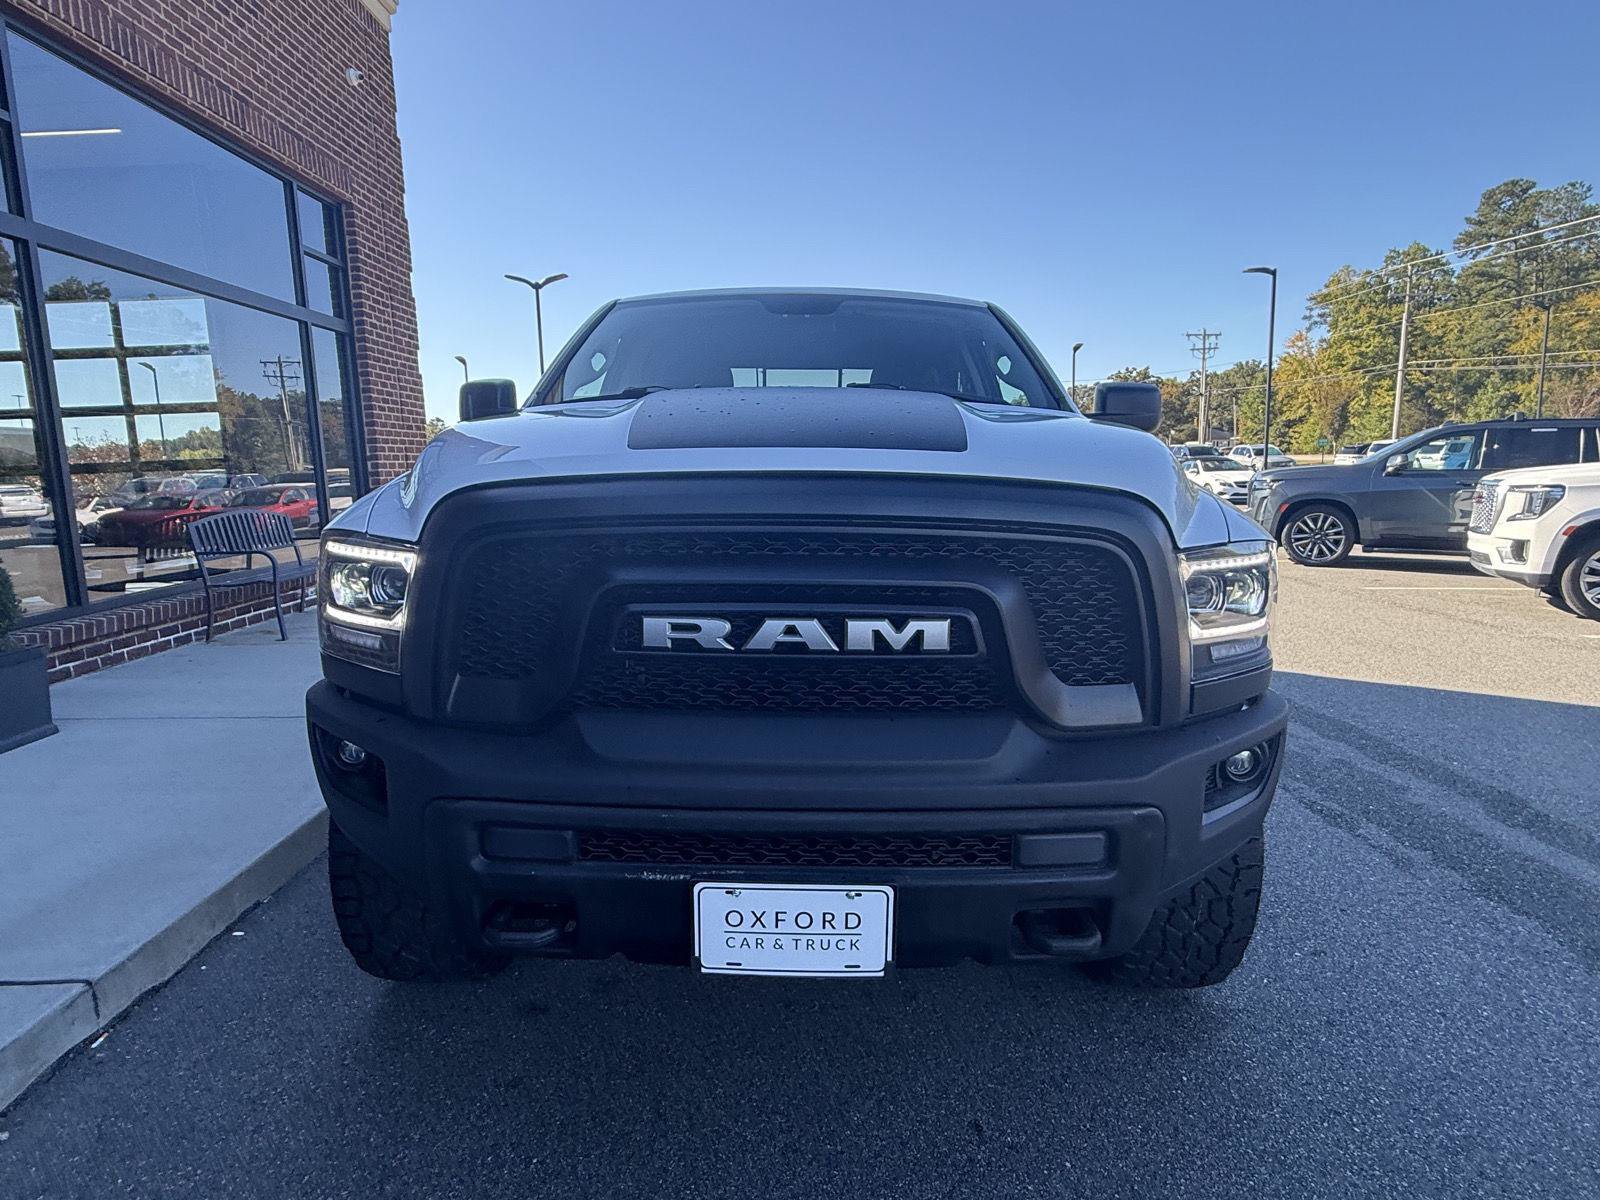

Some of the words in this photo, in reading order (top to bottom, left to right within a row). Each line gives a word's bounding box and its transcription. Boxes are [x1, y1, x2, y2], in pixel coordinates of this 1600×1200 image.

[642, 616, 951, 651] RAM
[724, 910, 862, 930] OXFORD
[725, 937, 765, 950] CAR
[773, 939, 785, 951] &
[792, 938, 860, 951] TRUCK
